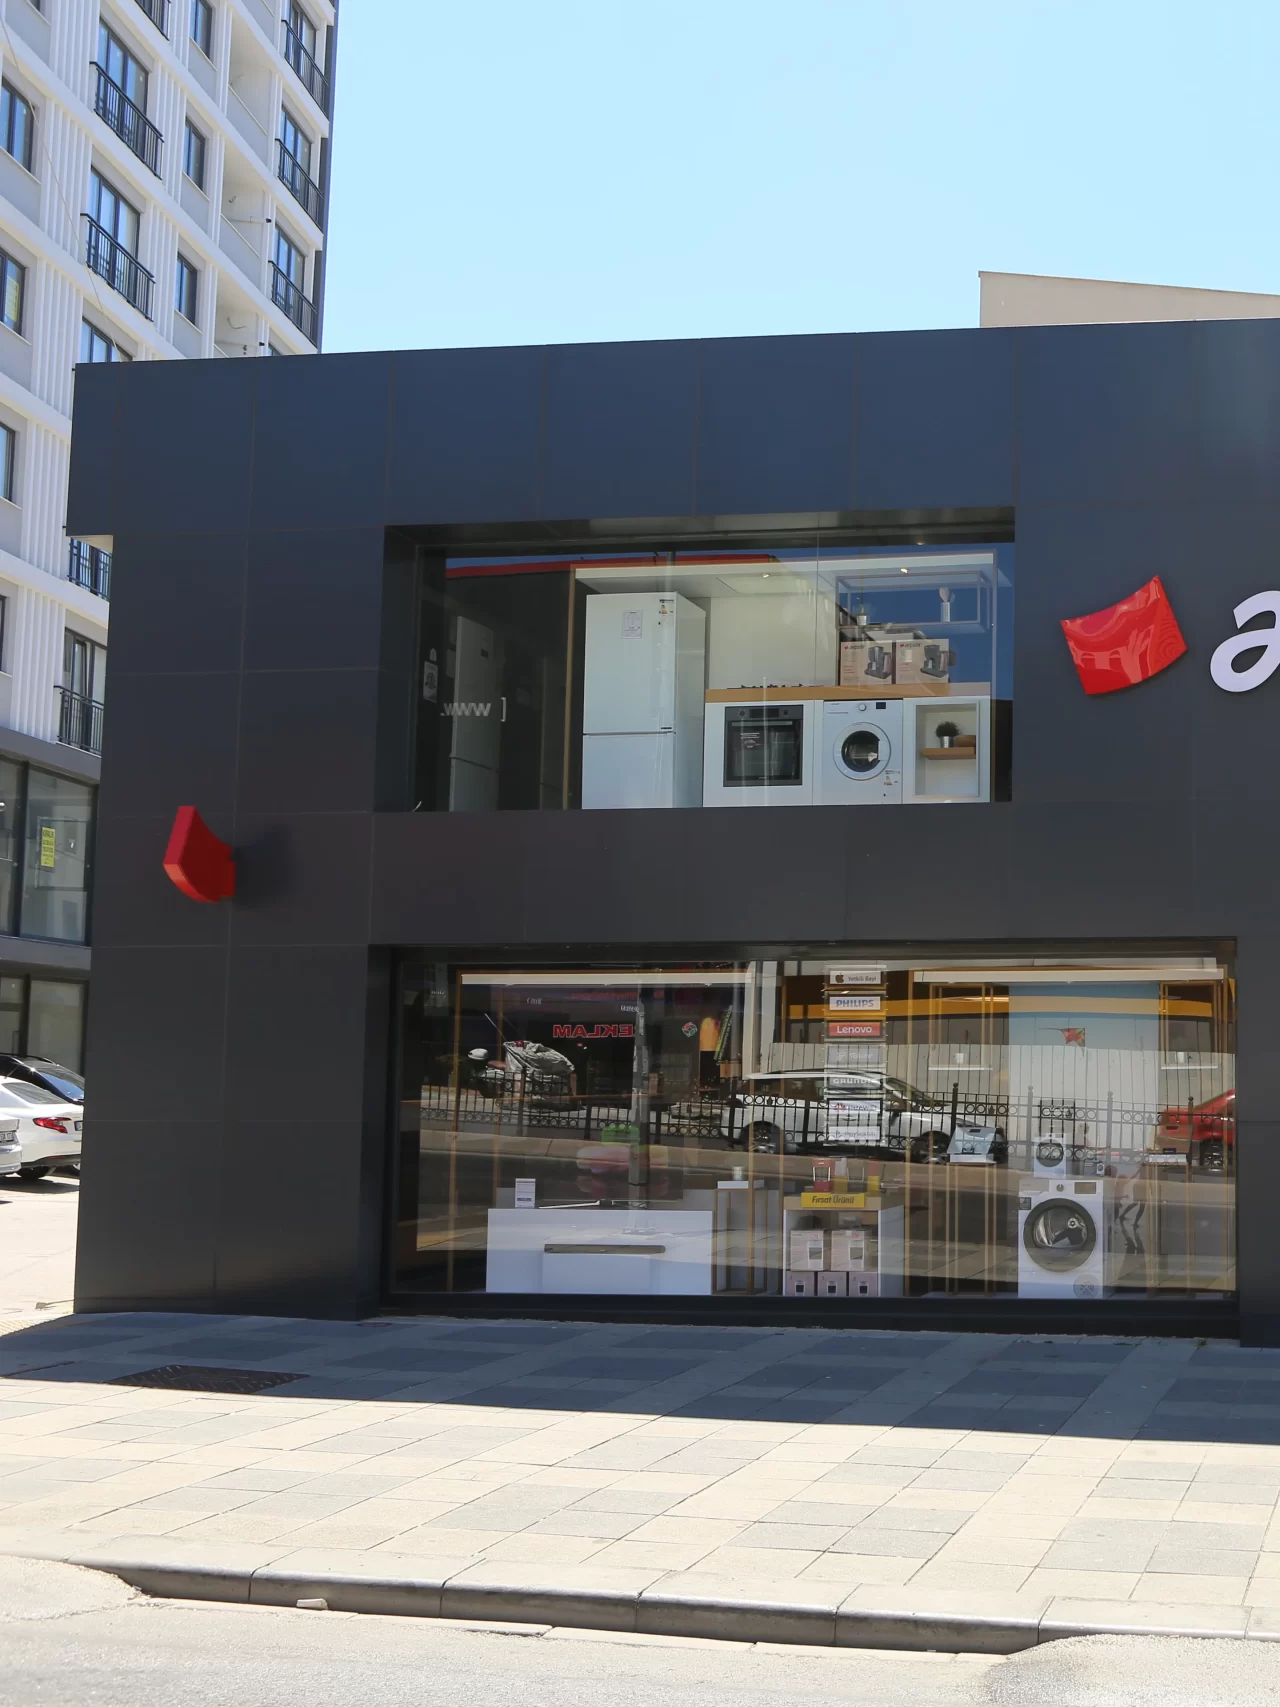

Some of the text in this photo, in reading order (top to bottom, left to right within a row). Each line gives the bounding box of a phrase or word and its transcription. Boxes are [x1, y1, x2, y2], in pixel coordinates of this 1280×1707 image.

[836, 999, 874, 1008] PHILIPS
[836, 1025, 873, 1034] Lenovo
[811, 1195, 855, 1204] Fırsat Ürünü
